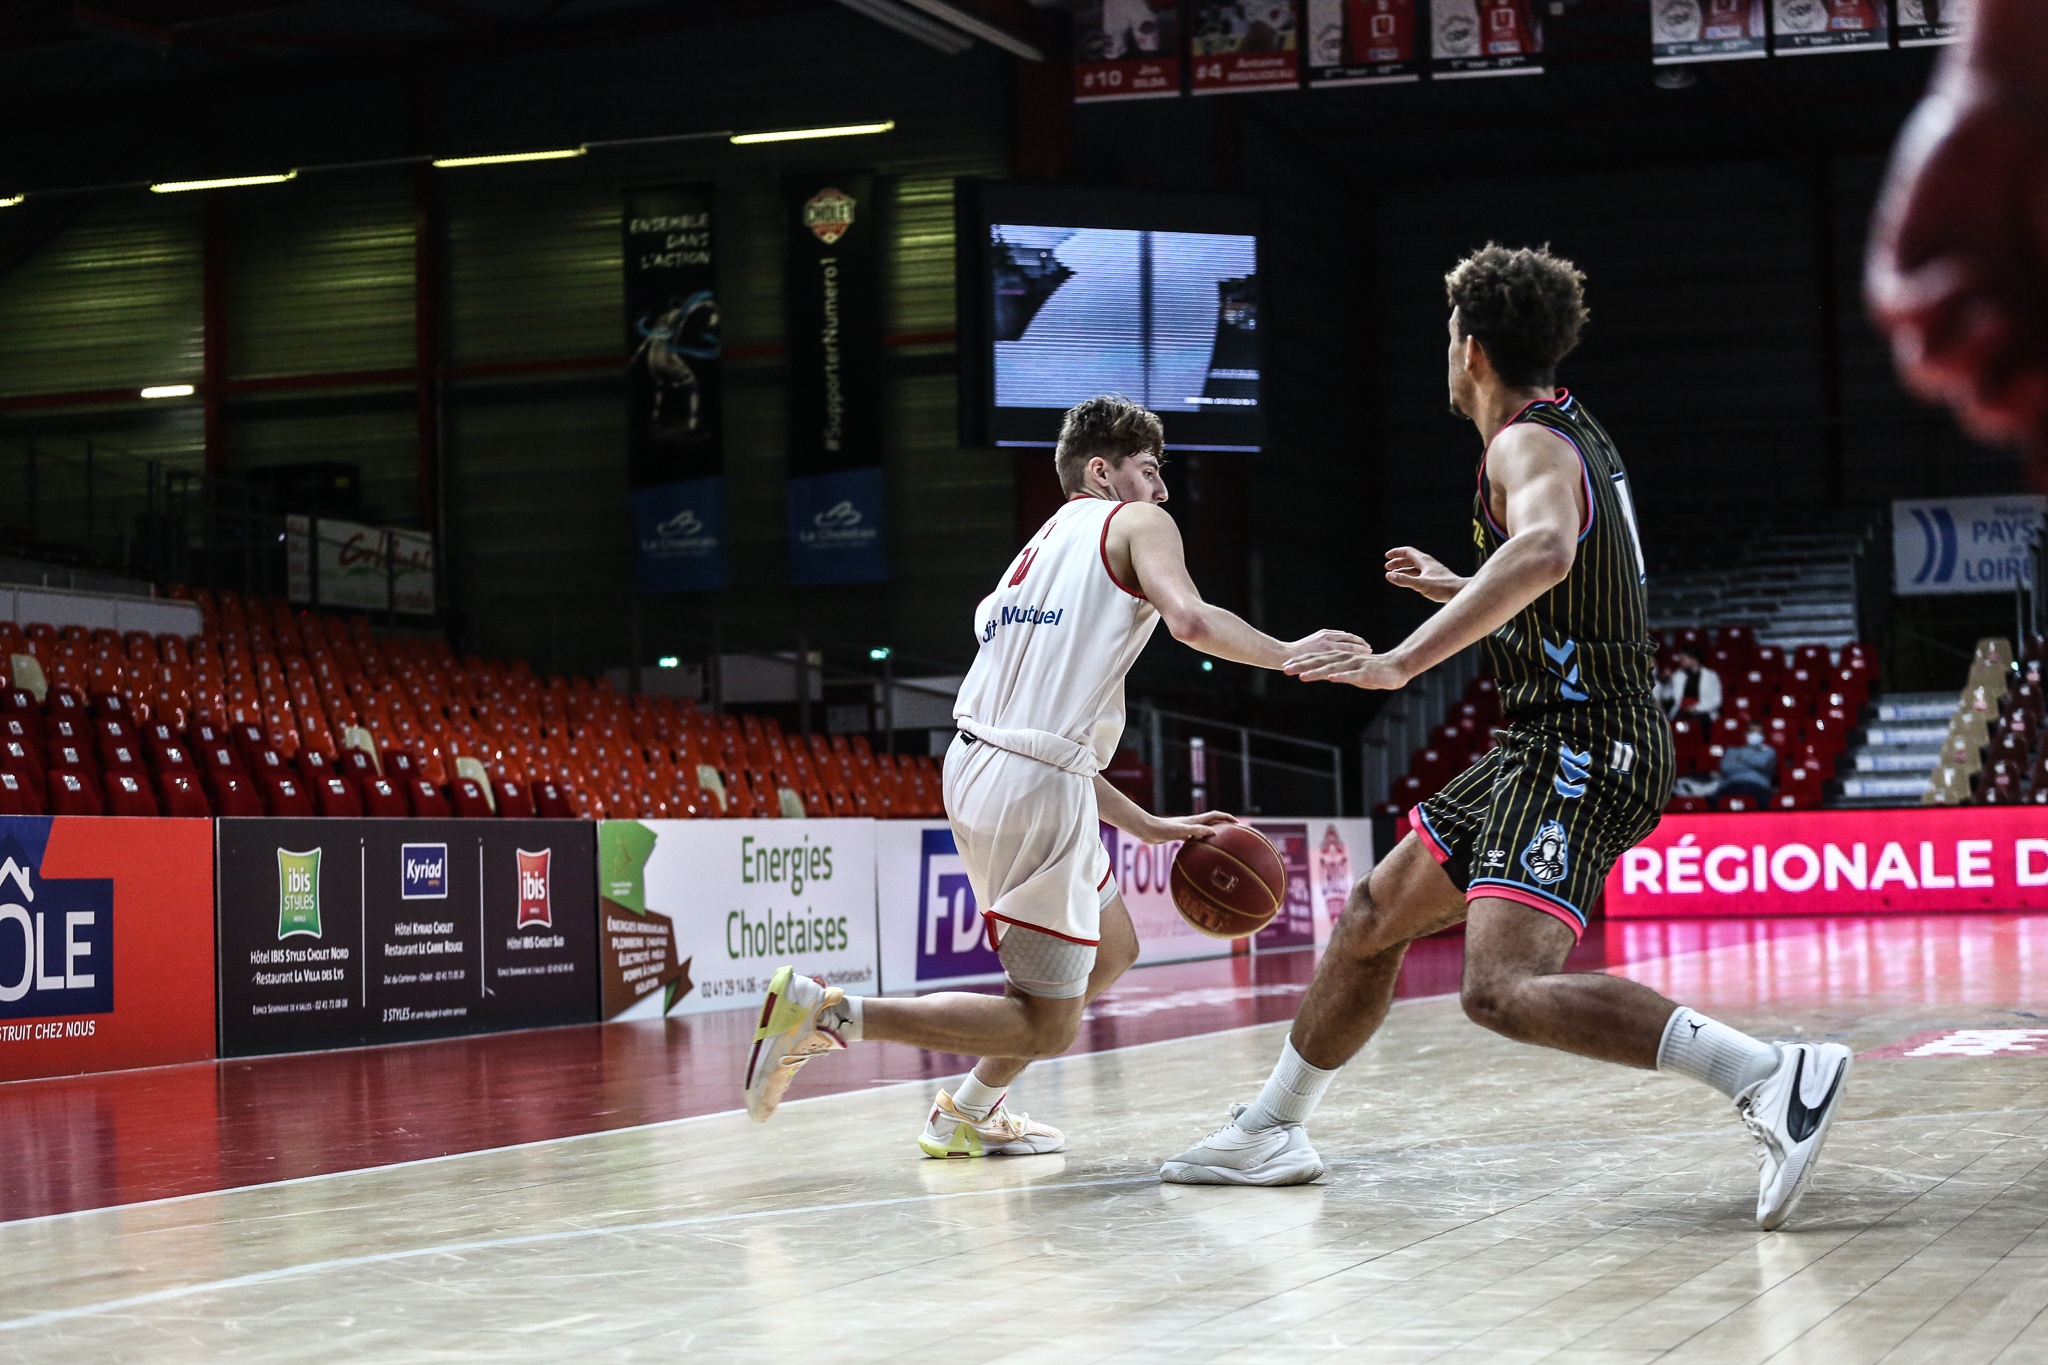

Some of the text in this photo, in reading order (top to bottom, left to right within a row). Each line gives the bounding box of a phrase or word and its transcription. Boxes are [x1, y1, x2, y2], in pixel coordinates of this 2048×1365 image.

[1082, 69, 1123, 88] #10
[1196, 63, 1222, 80] #4
[629, 212, 711, 235] ENSEMBLE
[665, 231, 711, 251] DANS
[640, 249, 711, 271] L'ACTION
[1972, 518, 2036, 545] PAYS
[1001, 604, 1064, 626] Mutuel
[406, 858, 442, 885] Kyriad
[742, 834, 834, 896] Energies
[1622, 834, 1994, 895] RÉGIONALE
[288, 867, 311, 892] ibis
[522, 871, 546, 901] ibis
[925, 853, 997, 955] FD
[394, 922, 412, 936] Hôtel
[726, 906, 849, 960] Choletaises
[250, 950, 270, 965] Hôtel
[270, 948, 284, 962] IBIS
[384, 942, 418, 957] Restaurant
[256, 970, 294, 986] Restaurant
[702, 981, 712, 998] 02
[713, 980, 724, 996] 41
[725, 979, 734, 996] 29
[382, 1008, 388, 1022] 3
[388, 1006, 410, 1022] STYLES
[35, 1022, 64, 1040] CHEZ
[66, 1020, 96, 1038] NOUS
